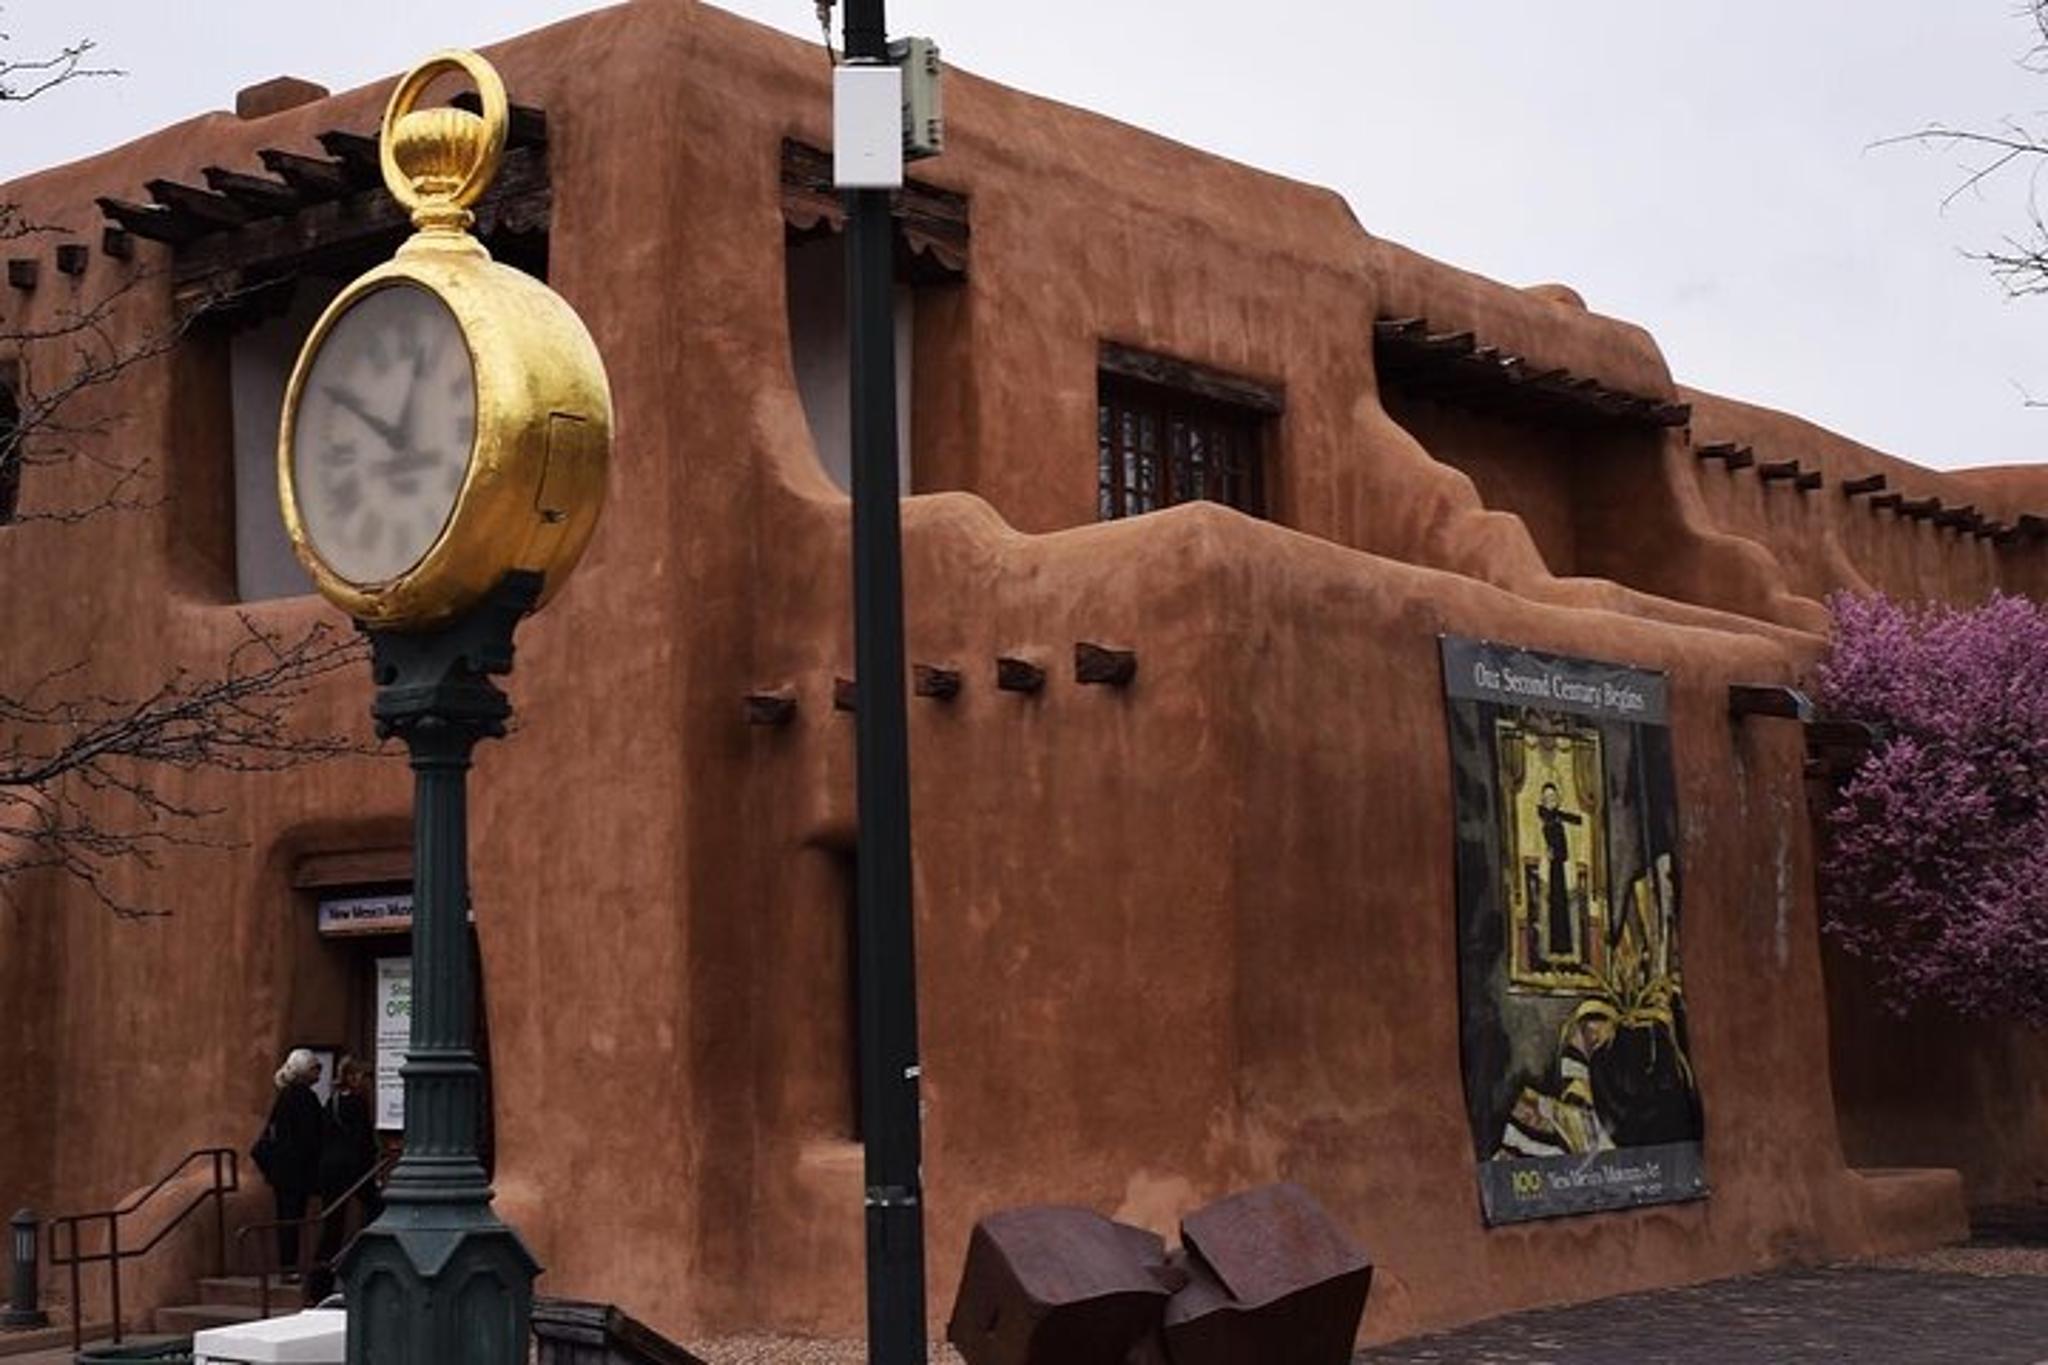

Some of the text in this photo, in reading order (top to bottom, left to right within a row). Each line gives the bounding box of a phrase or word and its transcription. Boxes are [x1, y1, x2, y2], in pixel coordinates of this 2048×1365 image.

[1503, 668, 1549, 697] Second
[1552, 675, 1602, 709] Century
[1604, 682, 1646, 713] Begins
[1512, 1170, 1542, 1193] 100
